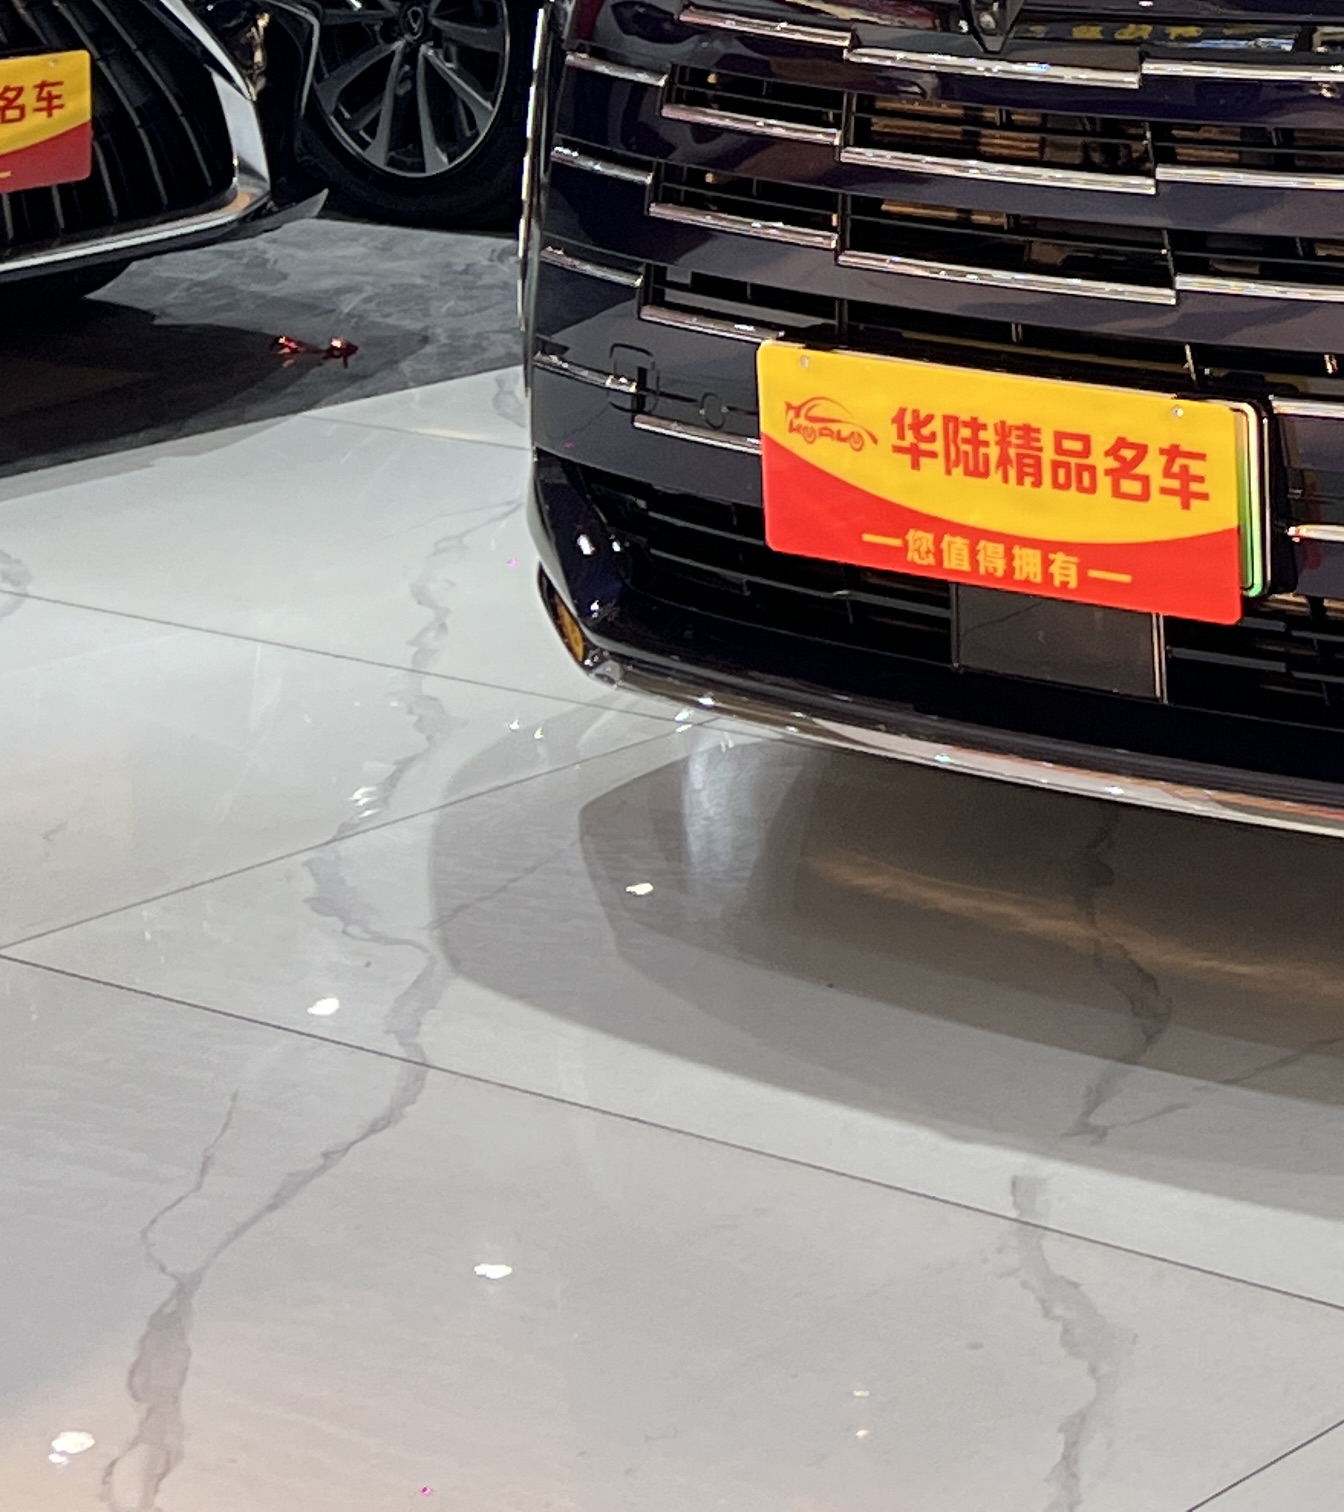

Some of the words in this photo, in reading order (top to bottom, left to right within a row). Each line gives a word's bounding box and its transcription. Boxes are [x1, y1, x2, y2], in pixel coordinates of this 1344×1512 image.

[892, 405, 1210, 511] 华陆精品名车
